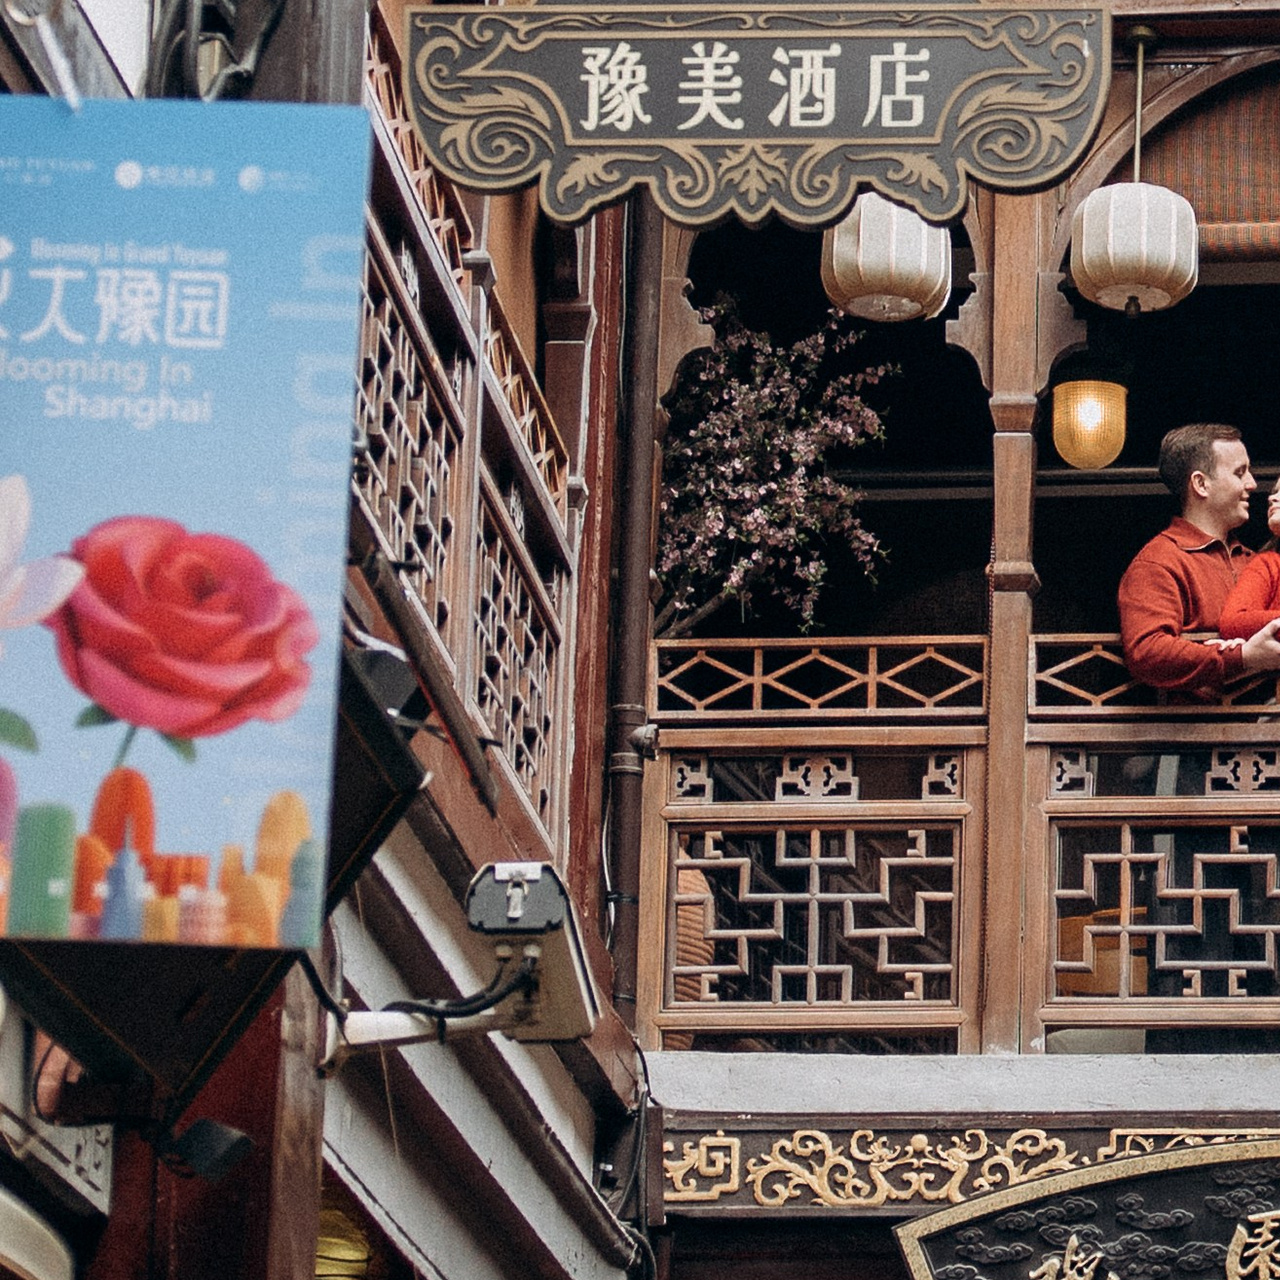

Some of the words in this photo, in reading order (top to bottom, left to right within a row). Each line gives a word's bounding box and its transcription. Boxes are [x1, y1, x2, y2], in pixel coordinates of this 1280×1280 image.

[578, 41, 932, 133] 豫美酒店
[43, 384, 214, 431] Shanghai
